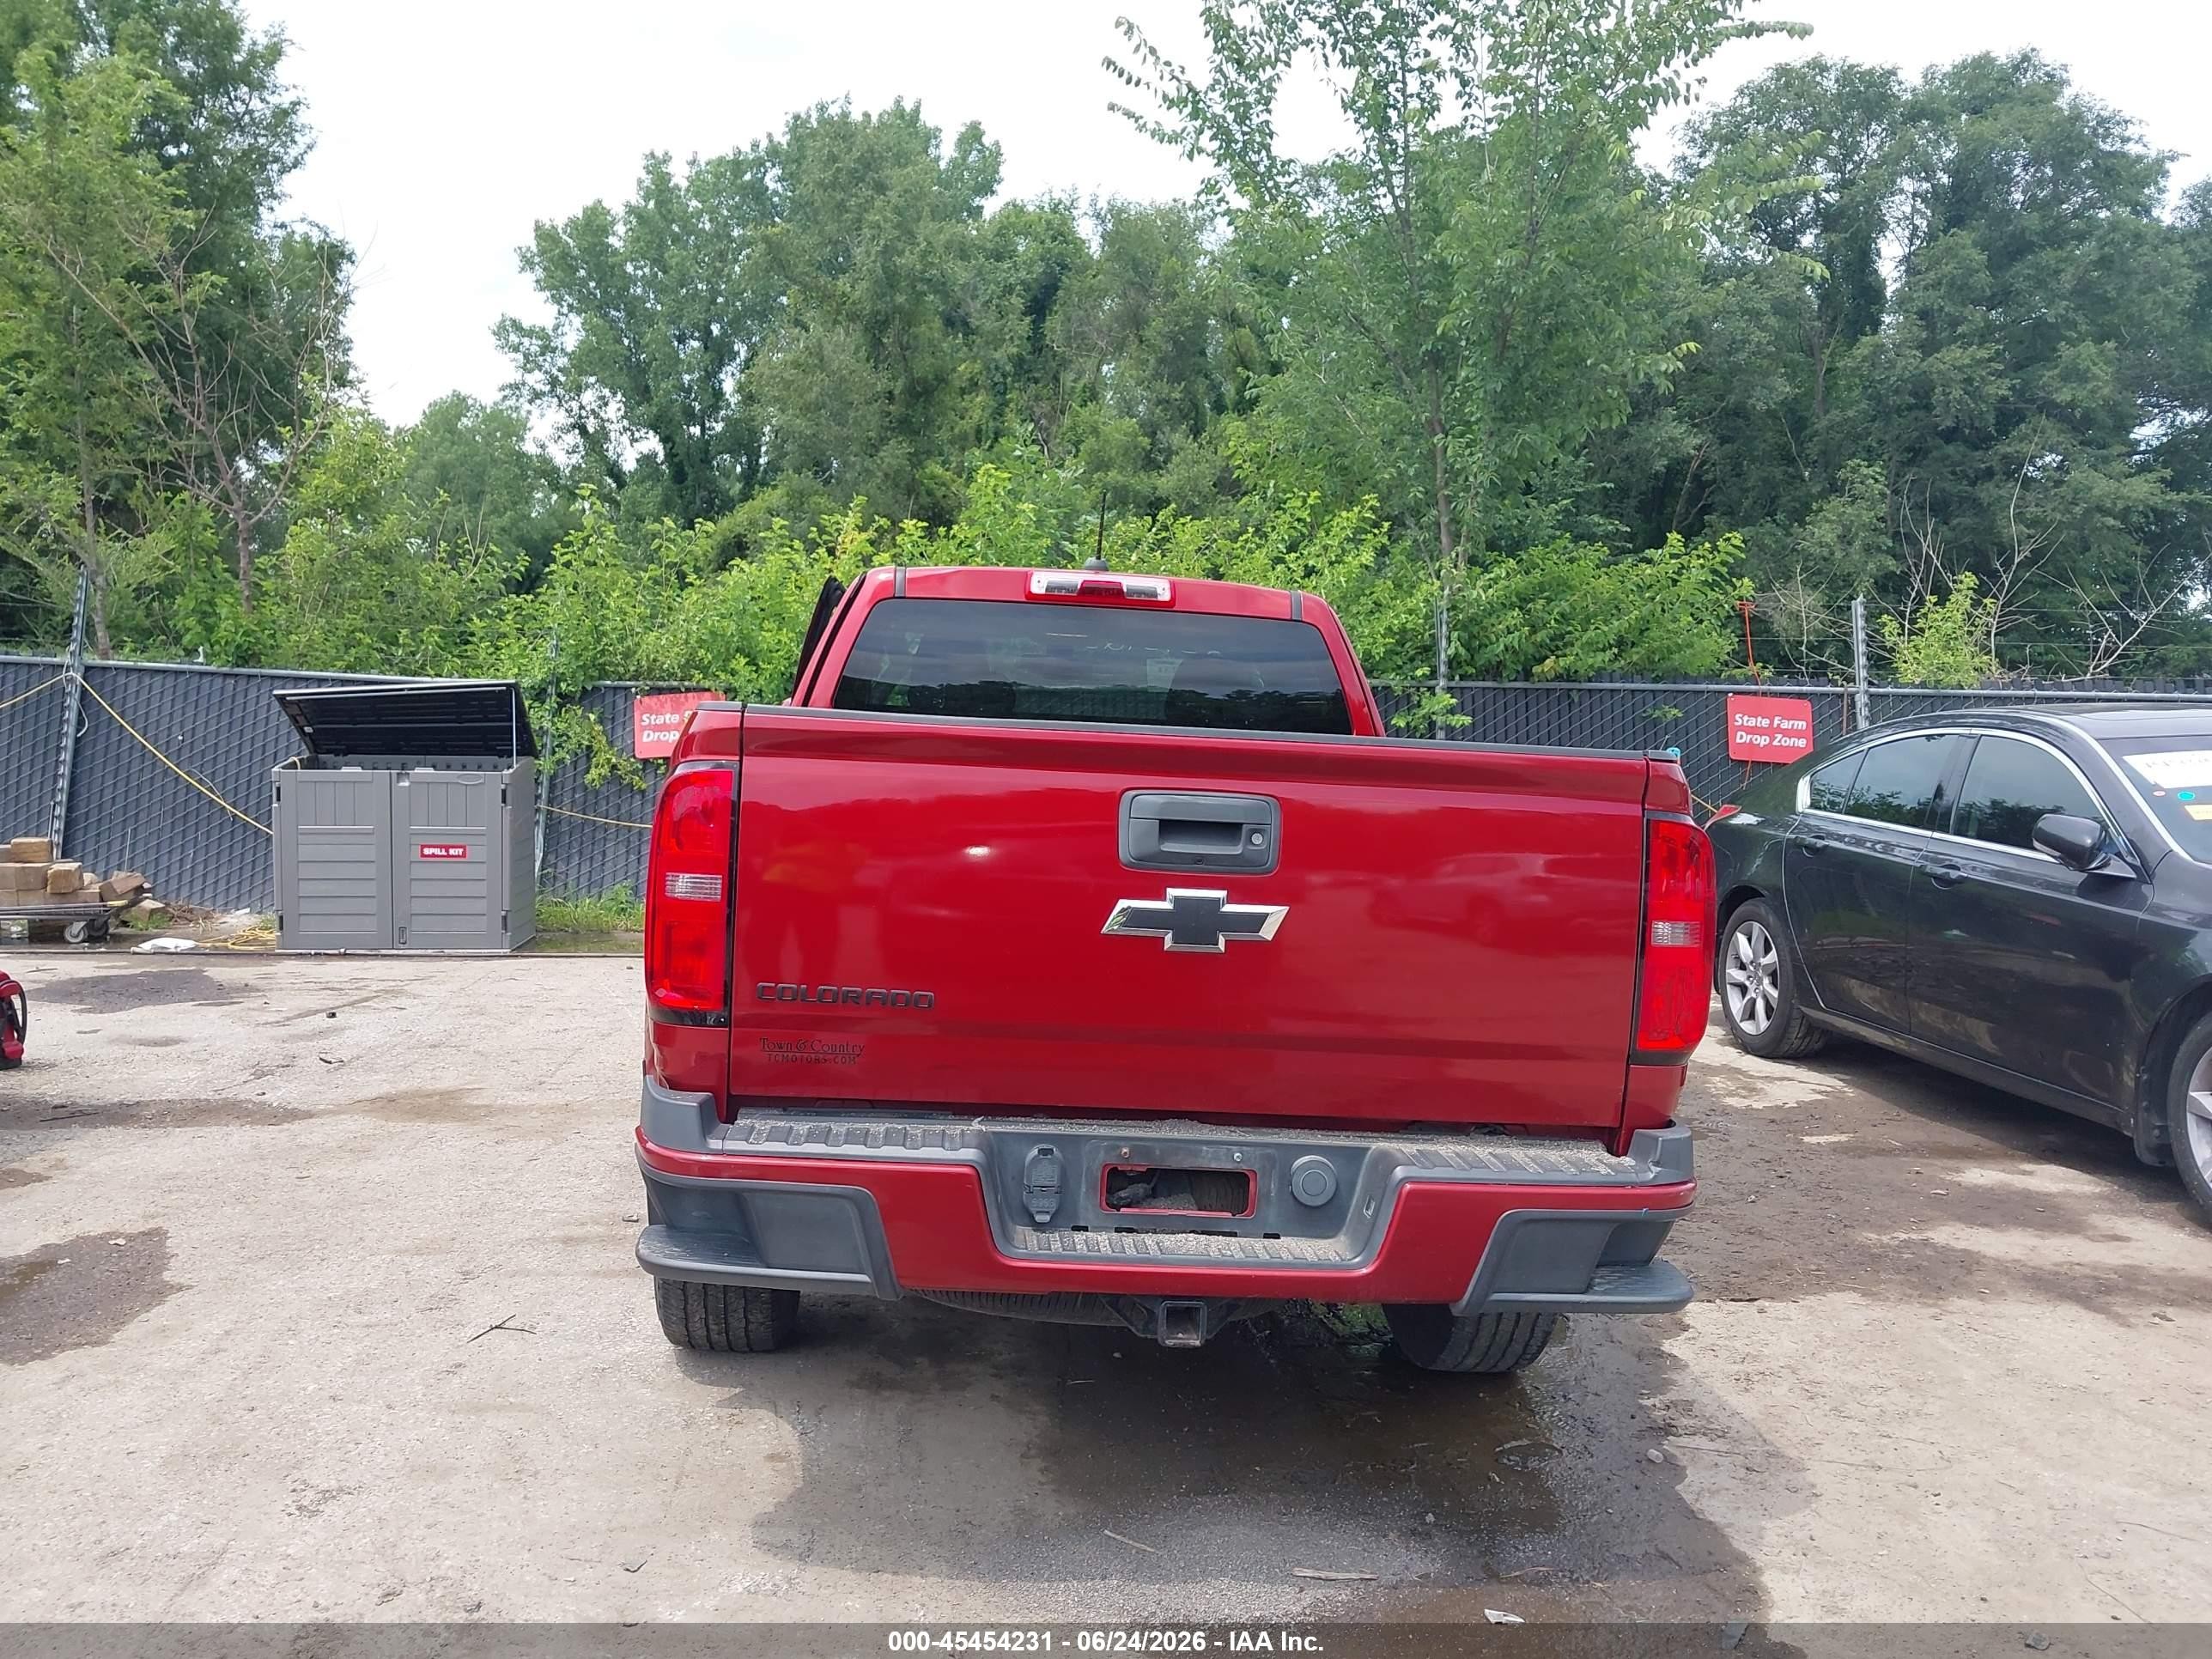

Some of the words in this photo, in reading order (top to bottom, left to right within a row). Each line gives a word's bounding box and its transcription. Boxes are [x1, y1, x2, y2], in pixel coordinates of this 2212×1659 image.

[641, 713, 680, 726] State
[1734, 714, 1771, 728] State
[1773, 716, 1807, 731] Farm
[642, 730, 680, 744] Drop
[1735, 731, 1771, 748] Drop
[1772, 733, 1808, 748] Zone
[756, 981, 935, 1009] COLORADO
[759, 1037, 793, 1052] Town
[795, 1038, 807, 1052] &
[810, 1039, 866, 1057] Country
